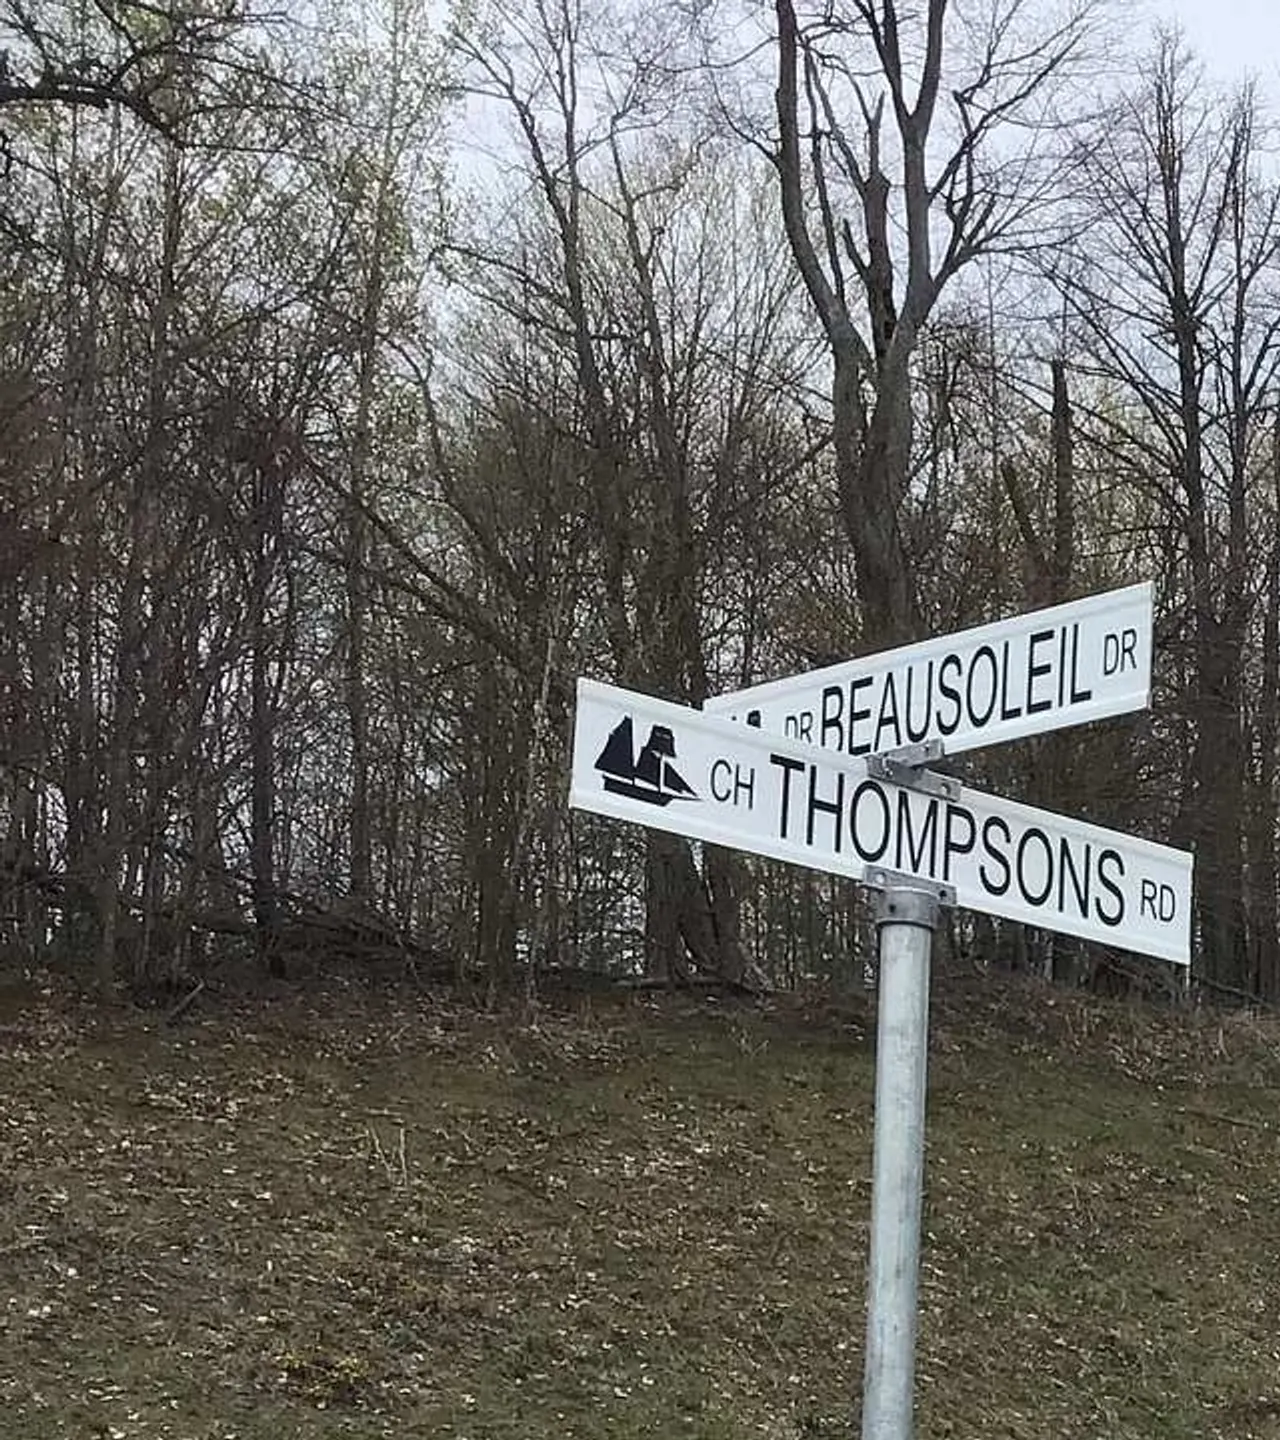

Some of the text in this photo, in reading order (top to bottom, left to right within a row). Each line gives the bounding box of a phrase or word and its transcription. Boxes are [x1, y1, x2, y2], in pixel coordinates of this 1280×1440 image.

[821, 624, 1092, 756] BEAUSOLEIL
[1104, 628, 1138, 677] DR
[710, 754, 1178, 927] CH THOMPSONS RD
